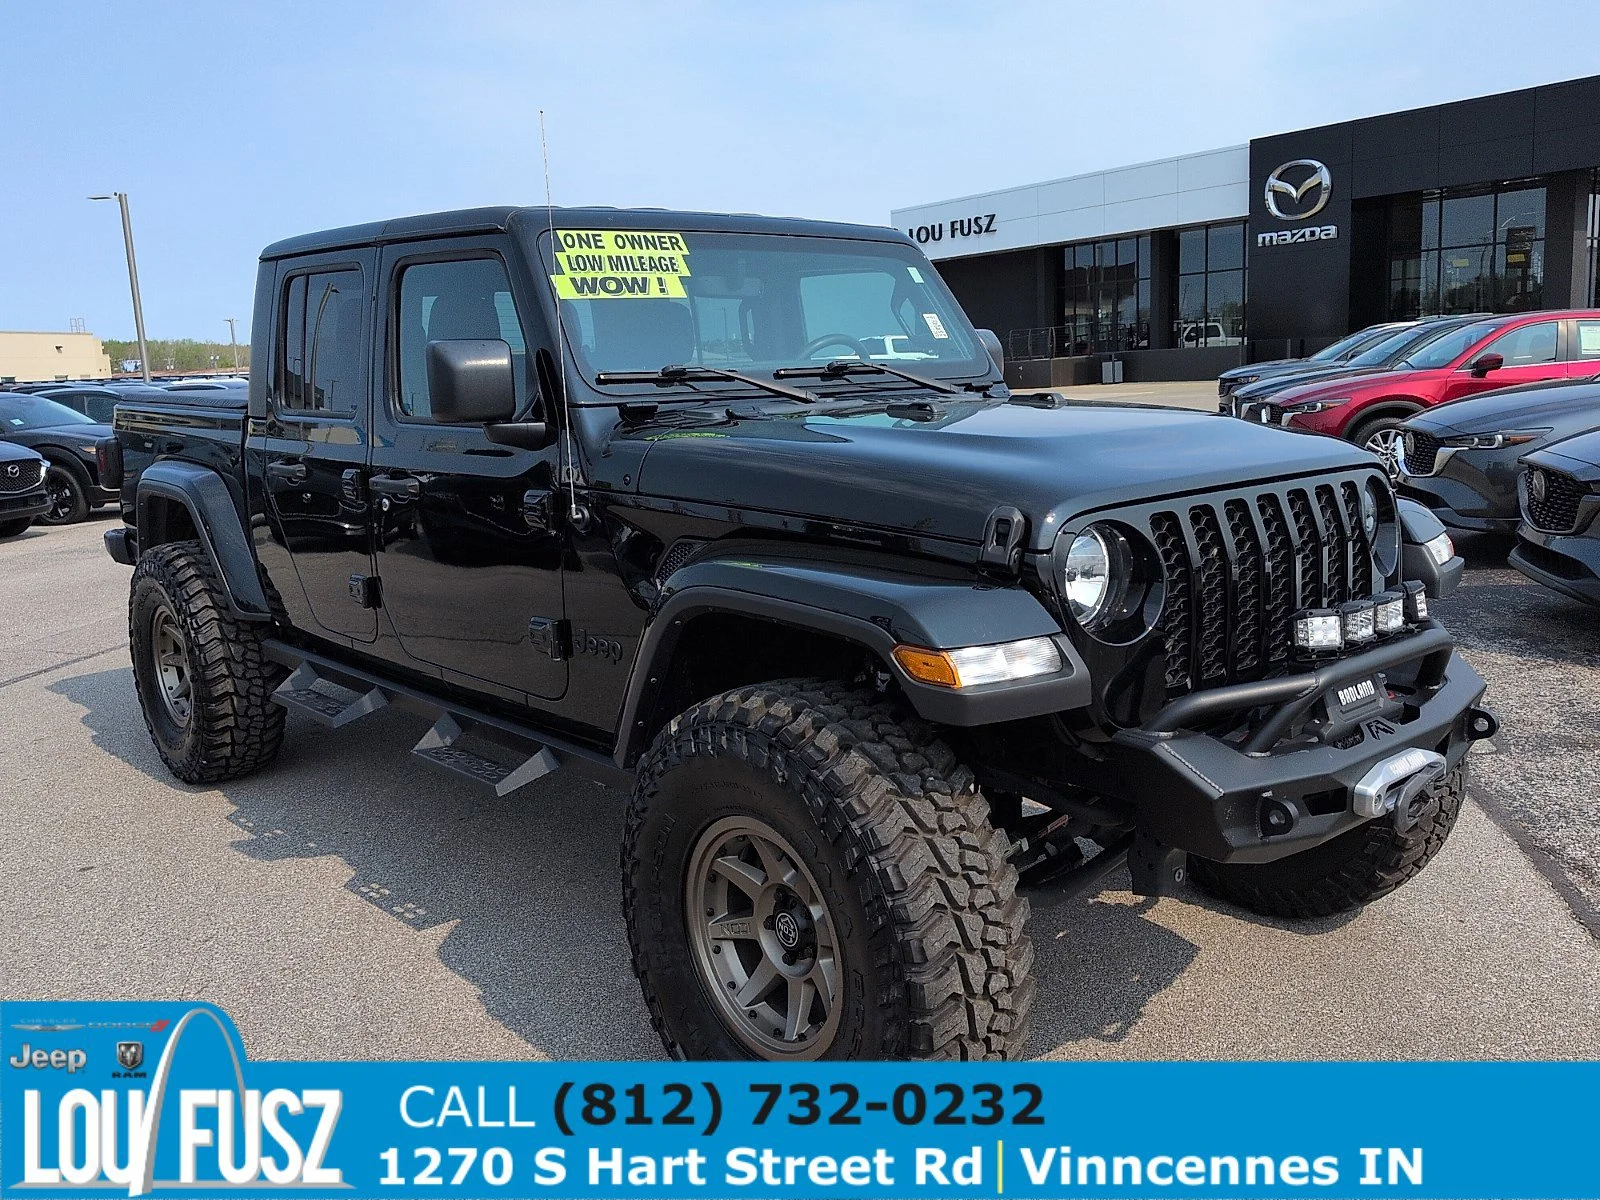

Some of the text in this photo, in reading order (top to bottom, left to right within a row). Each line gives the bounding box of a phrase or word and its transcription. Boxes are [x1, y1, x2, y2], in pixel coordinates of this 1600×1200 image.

[949, 213, 998, 239] FUSZ
[1257, 225, 1339, 247] mazda
[563, 232, 684, 252] ONE OWNER
[566, 254, 680, 274] LOW MILEAGE
[569, 276, 650, 297] WOW
[573, 627, 624, 666] Jeep
[1337, 679, 1376, 707] BADLAND
[718, 922, 752, 936] ICON
